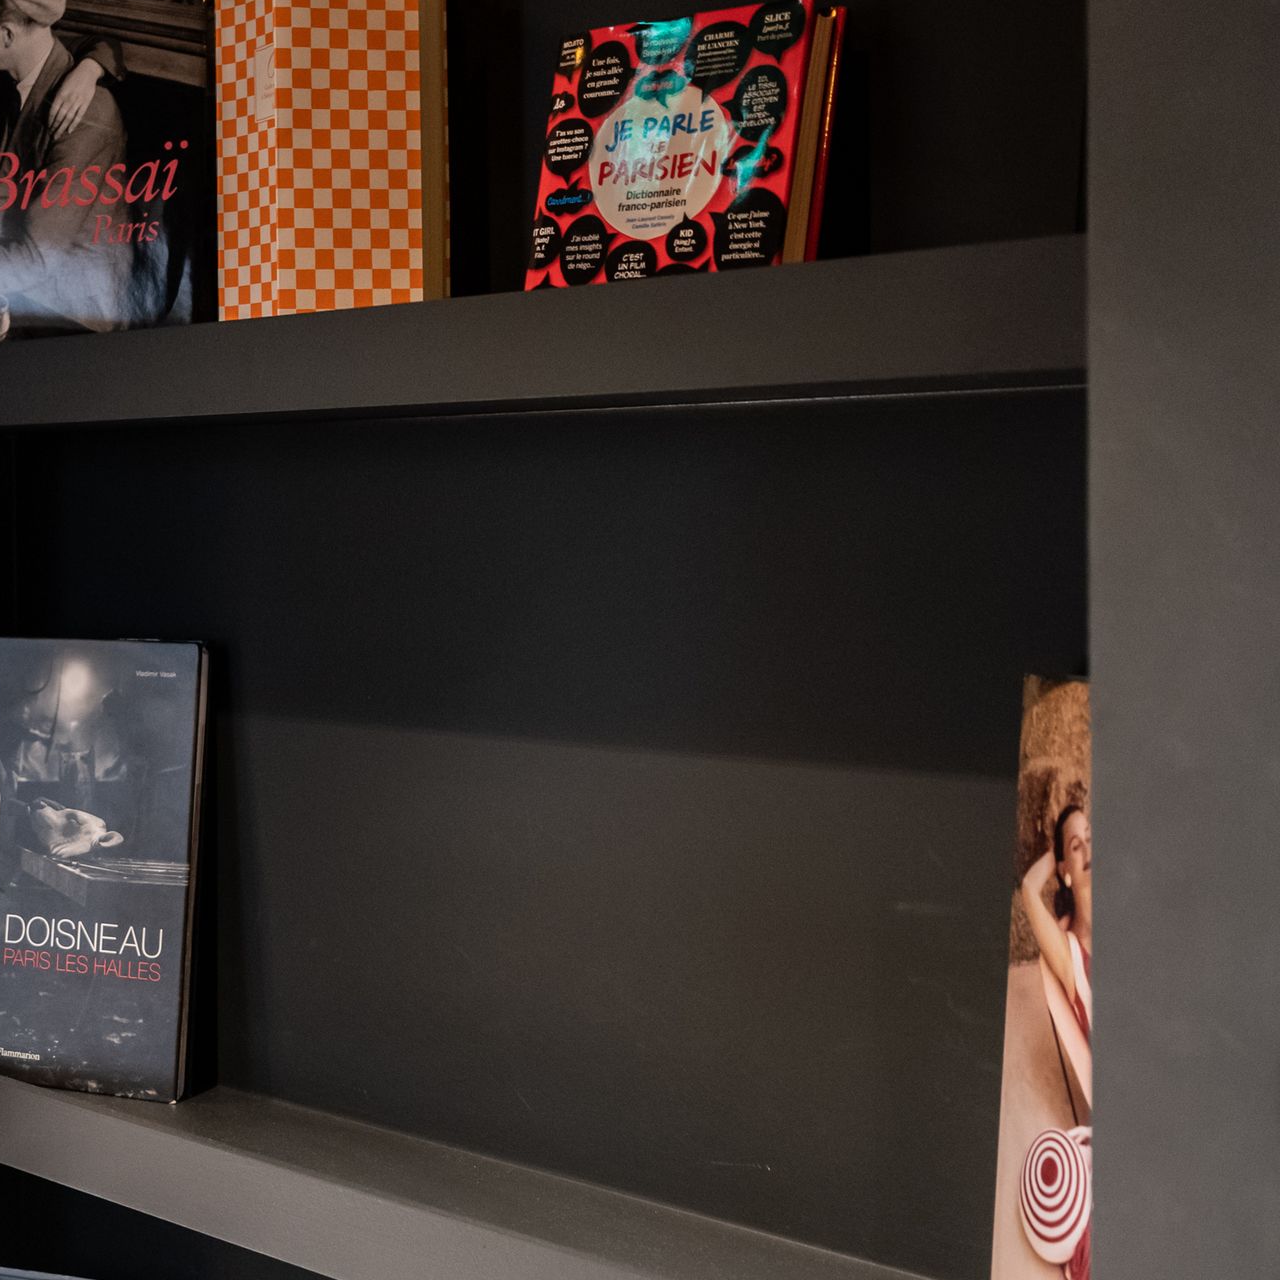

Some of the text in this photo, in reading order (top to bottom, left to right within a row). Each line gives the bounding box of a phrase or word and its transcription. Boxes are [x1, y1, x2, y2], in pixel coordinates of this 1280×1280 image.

[764, 11, 792, 23] SLICE
[704, 30, 736, 41] CHARME
[563, 38, 585, 48] MOJITO
[592, 58, 606, 67] Une
[593, 68, 607, 77] suis
[586, 77, 620, 89] en grande
[605, 110, 715, 153] JE PARLE
[556, 145, 583, 153] Instagram
[650, 141, 667, 154] LE
[598, 150, 717, 187] PARISIEN
[626, 187, 682, 201] Dictionnaire
[618, 198, 687, 213] franco-parisien
[93, 212, 161, 245] Paris
[533, 226, 555, 237] IT GIRL
[679, 229, 693, 238] KID
[581, 233, 600, 241] oublié
[579, 243, 602, 252] insights
[622, 252, 644, 262] C'EST
[617, 261, 646, 271] UN FILM
[4, 914, 163, 959] DOISNEAU
[2, 948, 161, 982] PARIS LES HALLES
